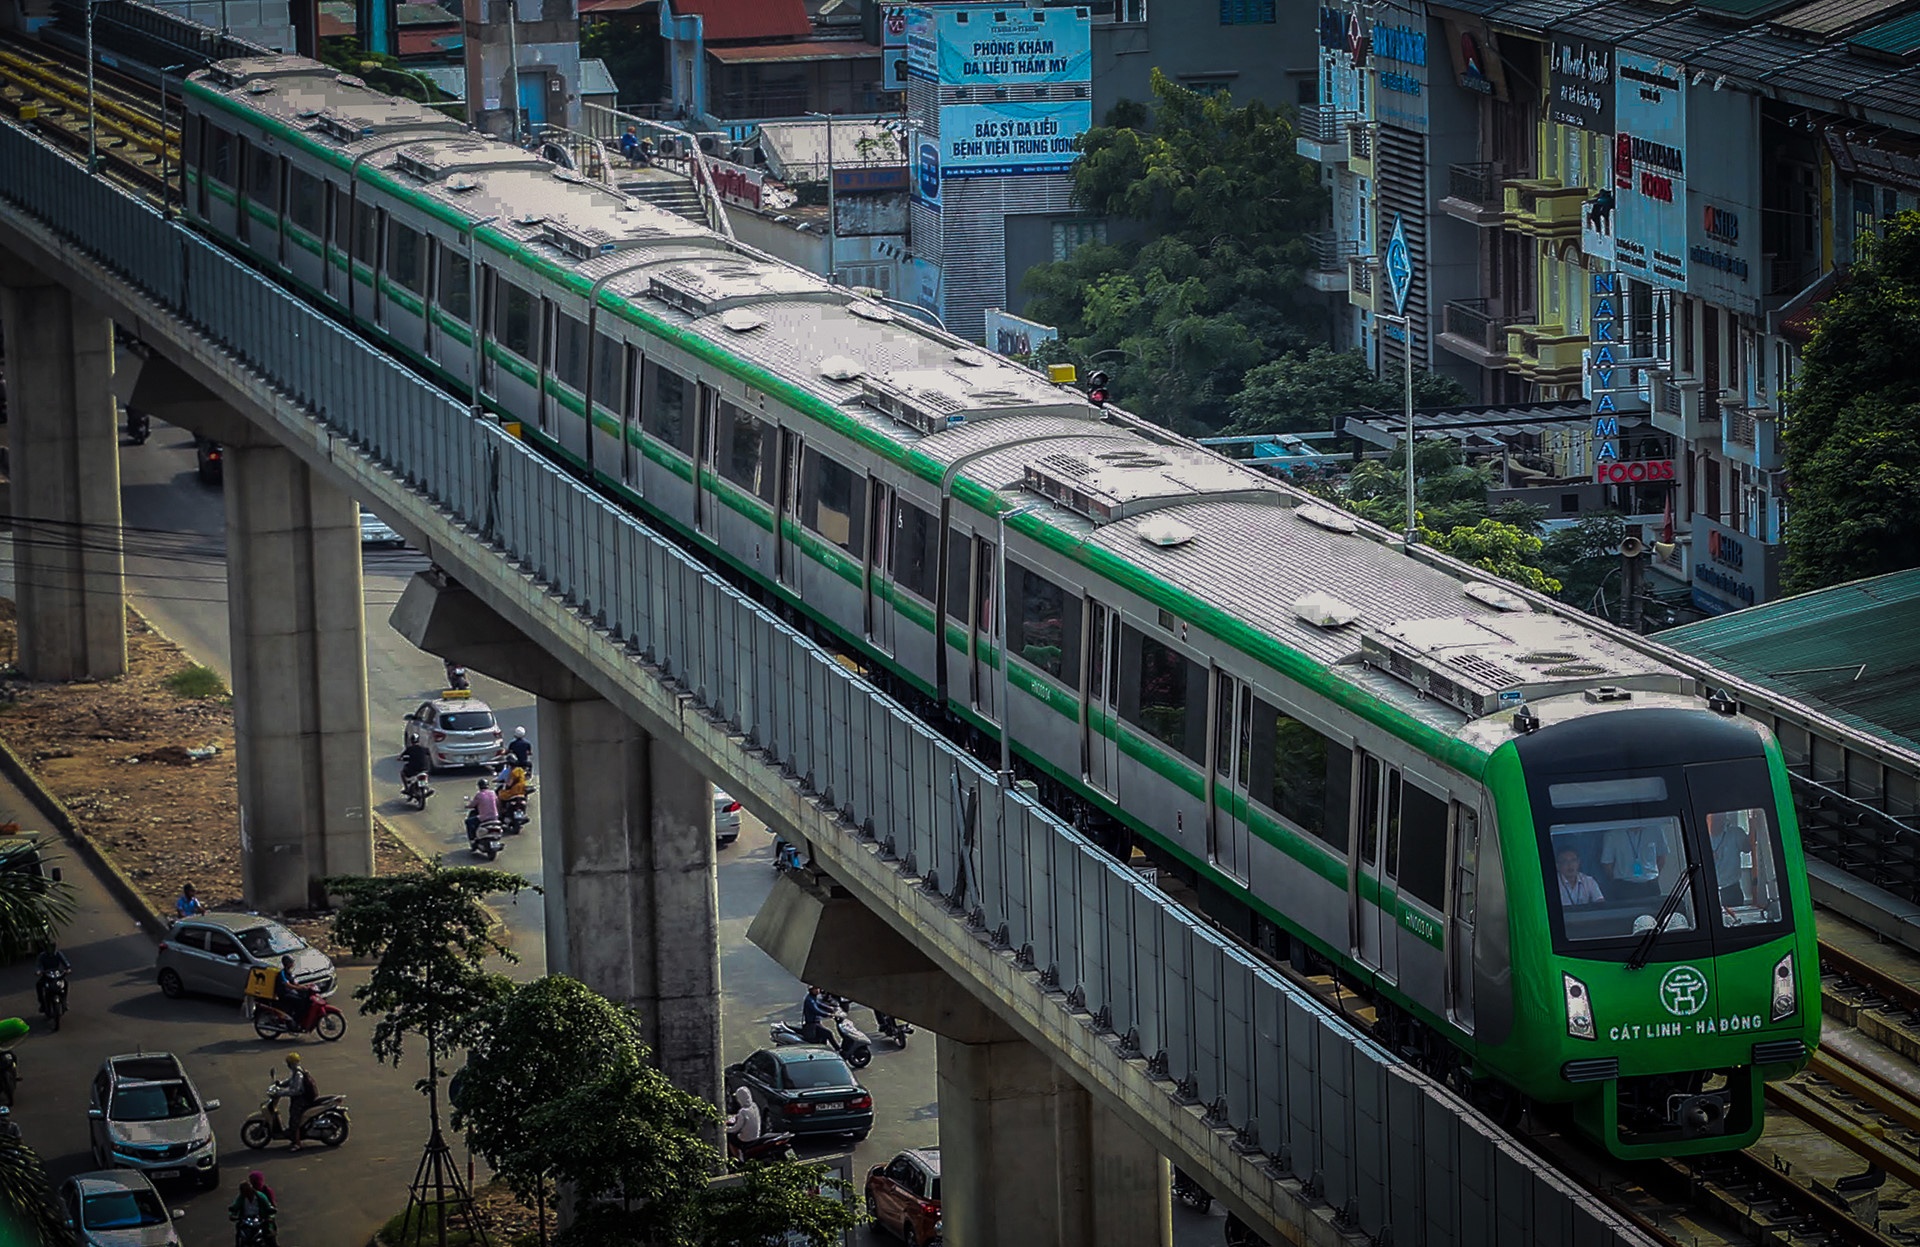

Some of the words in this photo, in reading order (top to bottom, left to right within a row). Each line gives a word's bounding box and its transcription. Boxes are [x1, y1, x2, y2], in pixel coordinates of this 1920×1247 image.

[1018, 39, 1053, 54] KHÁM
[963, 61, 979, 75] DA
[1011, 56, 1046, 74] THẨM
[1049, 57, 1068, 73] MỸ
[975, 121, 998, 138] BÁC
[1000, 119, 1014, 137] SỸ
[1017, 122, 1031, 135] DA
[953, 140, 982, 159] BỆNH
[985, 138, 1010, 158] VIỆN
[1012, 140, 1048, 153] TRUNG
[1632, 137, 1684, 173] NAKAYAMA
[1640, 172, 1673, 203] FOODS
[1714, 209, 1738, 240] SHB
[1594, 274, 1618, 460] NAKAYAMA
[1597, 461, 1674, 484] FOODS
[1609, 1023, 1641, 1041] CÁT
[1646, 1021, 1681, 1038] LINH
[1695, 1017, 1716, 1034] HÀ
[1719, 1014, 1762, 1032] ĐÔNG
